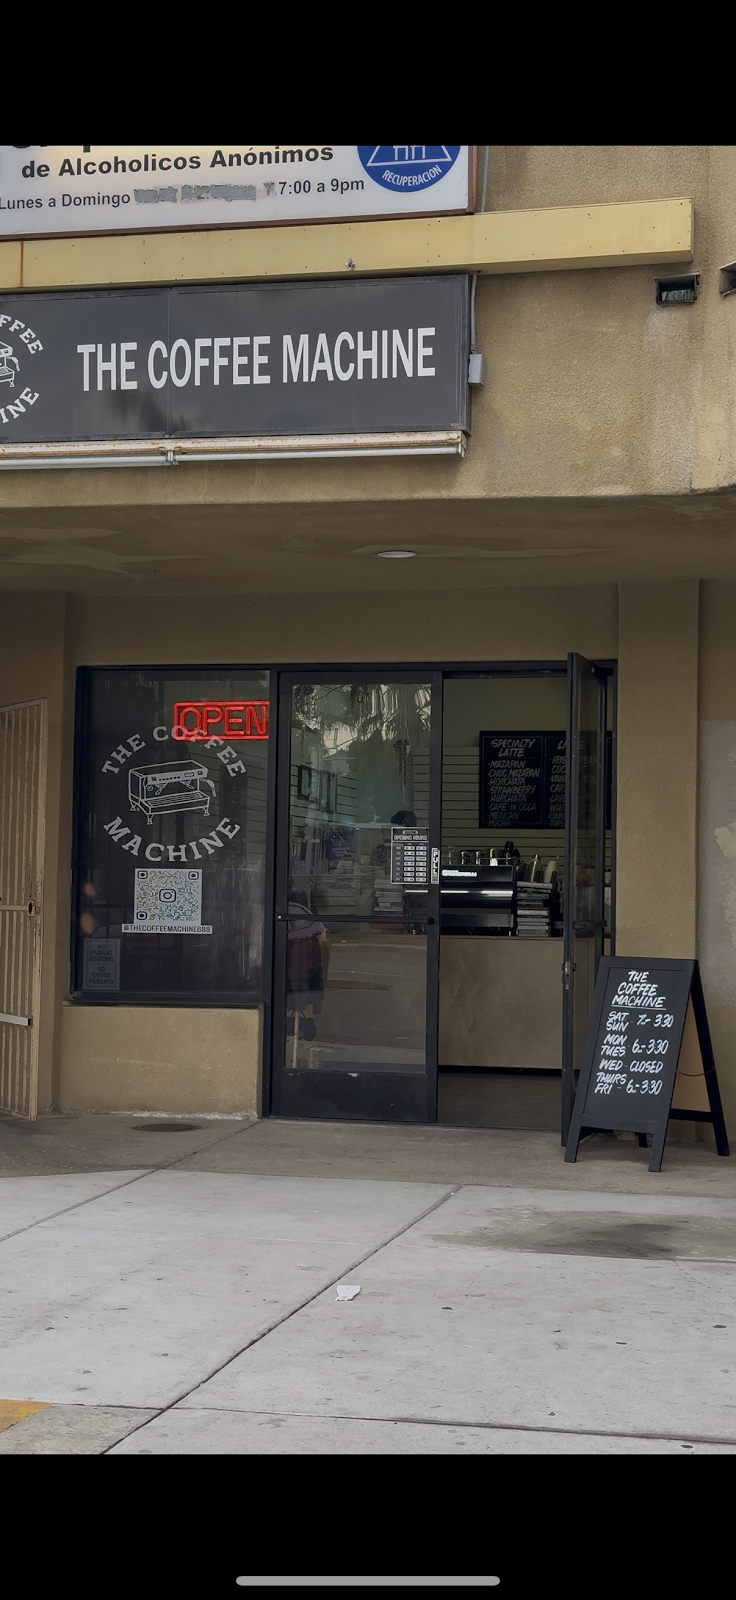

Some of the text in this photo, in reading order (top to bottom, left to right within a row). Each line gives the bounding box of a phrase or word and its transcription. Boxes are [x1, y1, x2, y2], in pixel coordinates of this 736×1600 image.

[21, 146, 334, 178] de Alcoholicos Anónimos
[381, 164, 443, 187] RECUPERACION
[0, 195, 43, 210] Lunes
[48, 196, 56, 208] a
[61, 191, 131, 208] Domingo
[278, 180, 311, 195] 7:00
[316, 182, 325, 193] a
[330, 178, 365, 195] 9pm
[76, 327, 436, 392] THE COFFEE MACHINE
[178, 705, 267, 737] OPEN
[491, 738, 536, 749] SPECIALTY
[101, 725, 247, 778] THE COFFEE
[497, 748, 525, 758] LATTE
[489, 785, 537, 795] STRAWBERRY
[489, 803, 508, 812] CAFE
[488, 811, 519, 820] MEXICAN
[103, 816, 241, 862] MACHINE
[628, 970, 649, 982] THE
[617, 982, 658, 996] COFFEE
[611, 995, 666, 1008] MACHINE
[629, 1060, 664, 1073] CLOSED
[596, 1072, 627, 1085] THURS
